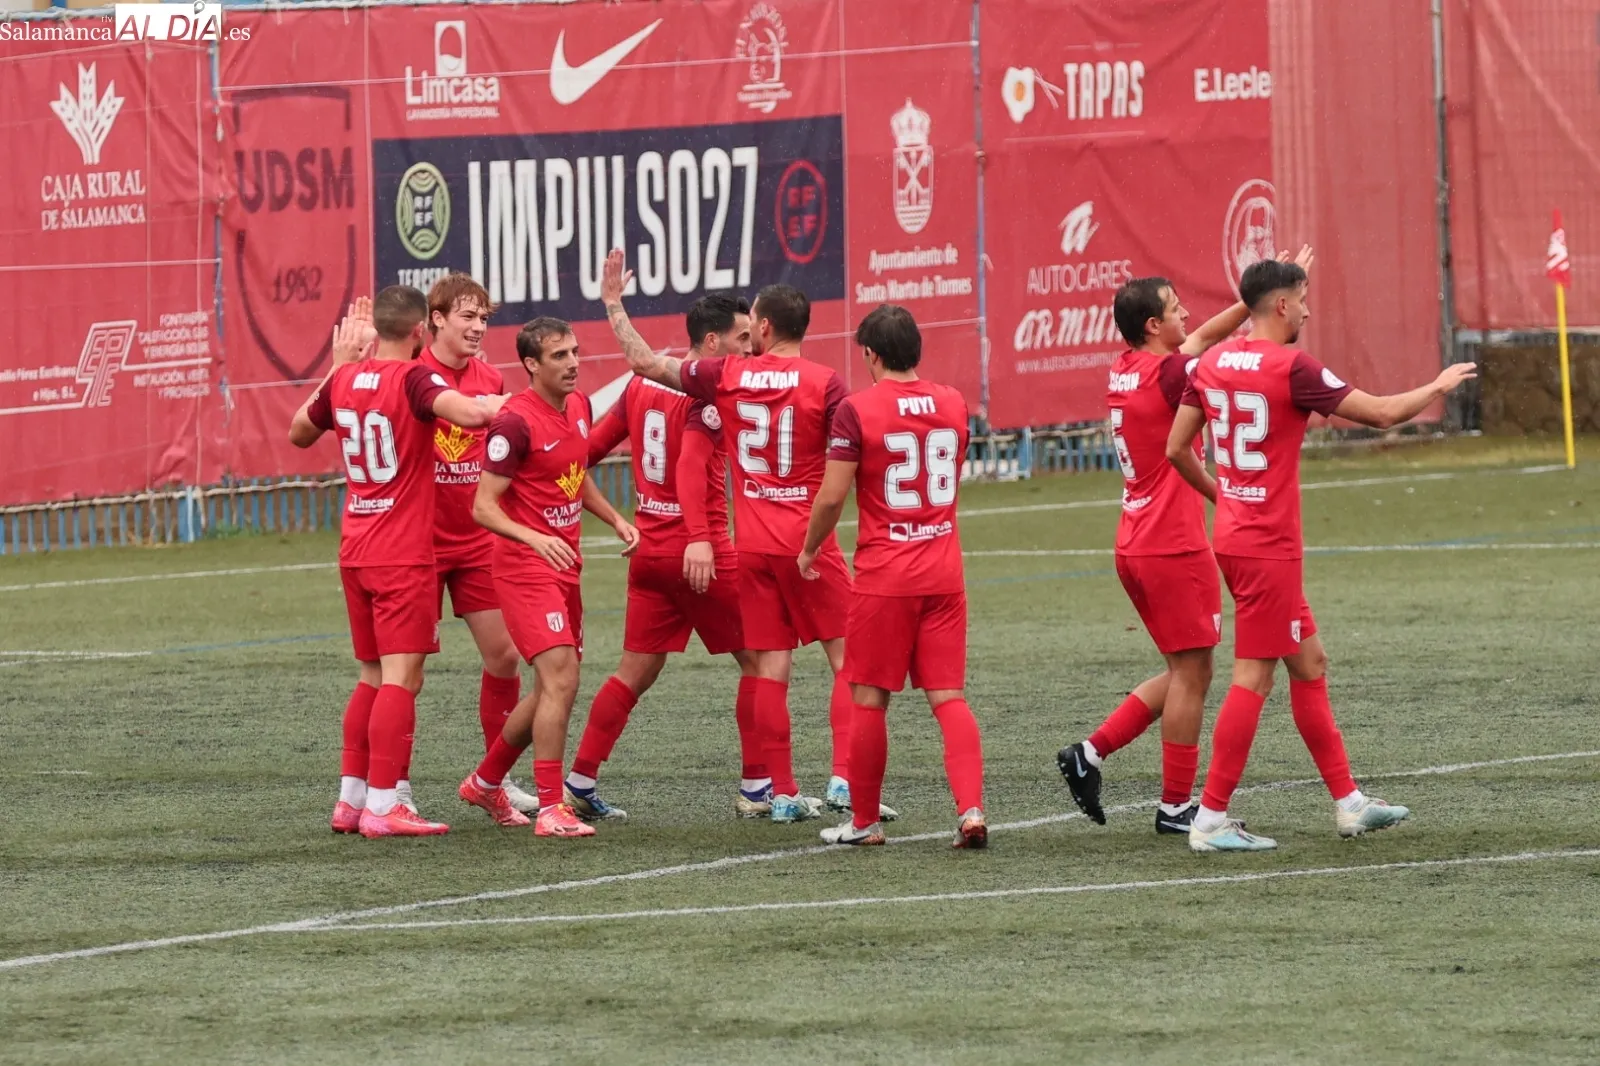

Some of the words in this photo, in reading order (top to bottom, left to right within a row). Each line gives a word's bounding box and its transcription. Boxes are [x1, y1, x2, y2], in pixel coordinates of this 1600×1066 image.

[405, 65, 500, 105] Limcasa
[1063, 60, 1145, 120] TAPAS
[1194, 65, 1272, 102] E.Lecle
[41, 174, 84, 207] CAJA
[87, 169, 146, 199] RURAL
[235, 147, 355, 214] UDSM
[41, 209, 60, 231] DE
[61, 203, 146, 228] SALAMANCA
[468, 146, 760, 305] IMPULSO27
[868, 245, 943, 276] Ayuntamiento
[944, 242, 958, 265] de
[1026, 259, 1134, 296] AUTOCARES
[855, 281, 887, 304] Santa
[887, 279, 920, 301] Marta
[921, 275, 935, 298] de
[934, 274, 973, 297] Tormes
[740, 371, 799, 389] RAZVAN
[897, 396, 936, 416] PUYI
[335, 408, 398, 483] 20
[641, 409, 667, 485] 8
[736, 400, 794, 478] 21
[1204, 388, 1269, 470] 22
[434, 474, 481, 484] ALAMANCA
[448, 461, 481, 473] RURAL
[884, 428, 959, 510] 28
[543, 504, 569, 518] CAJA
